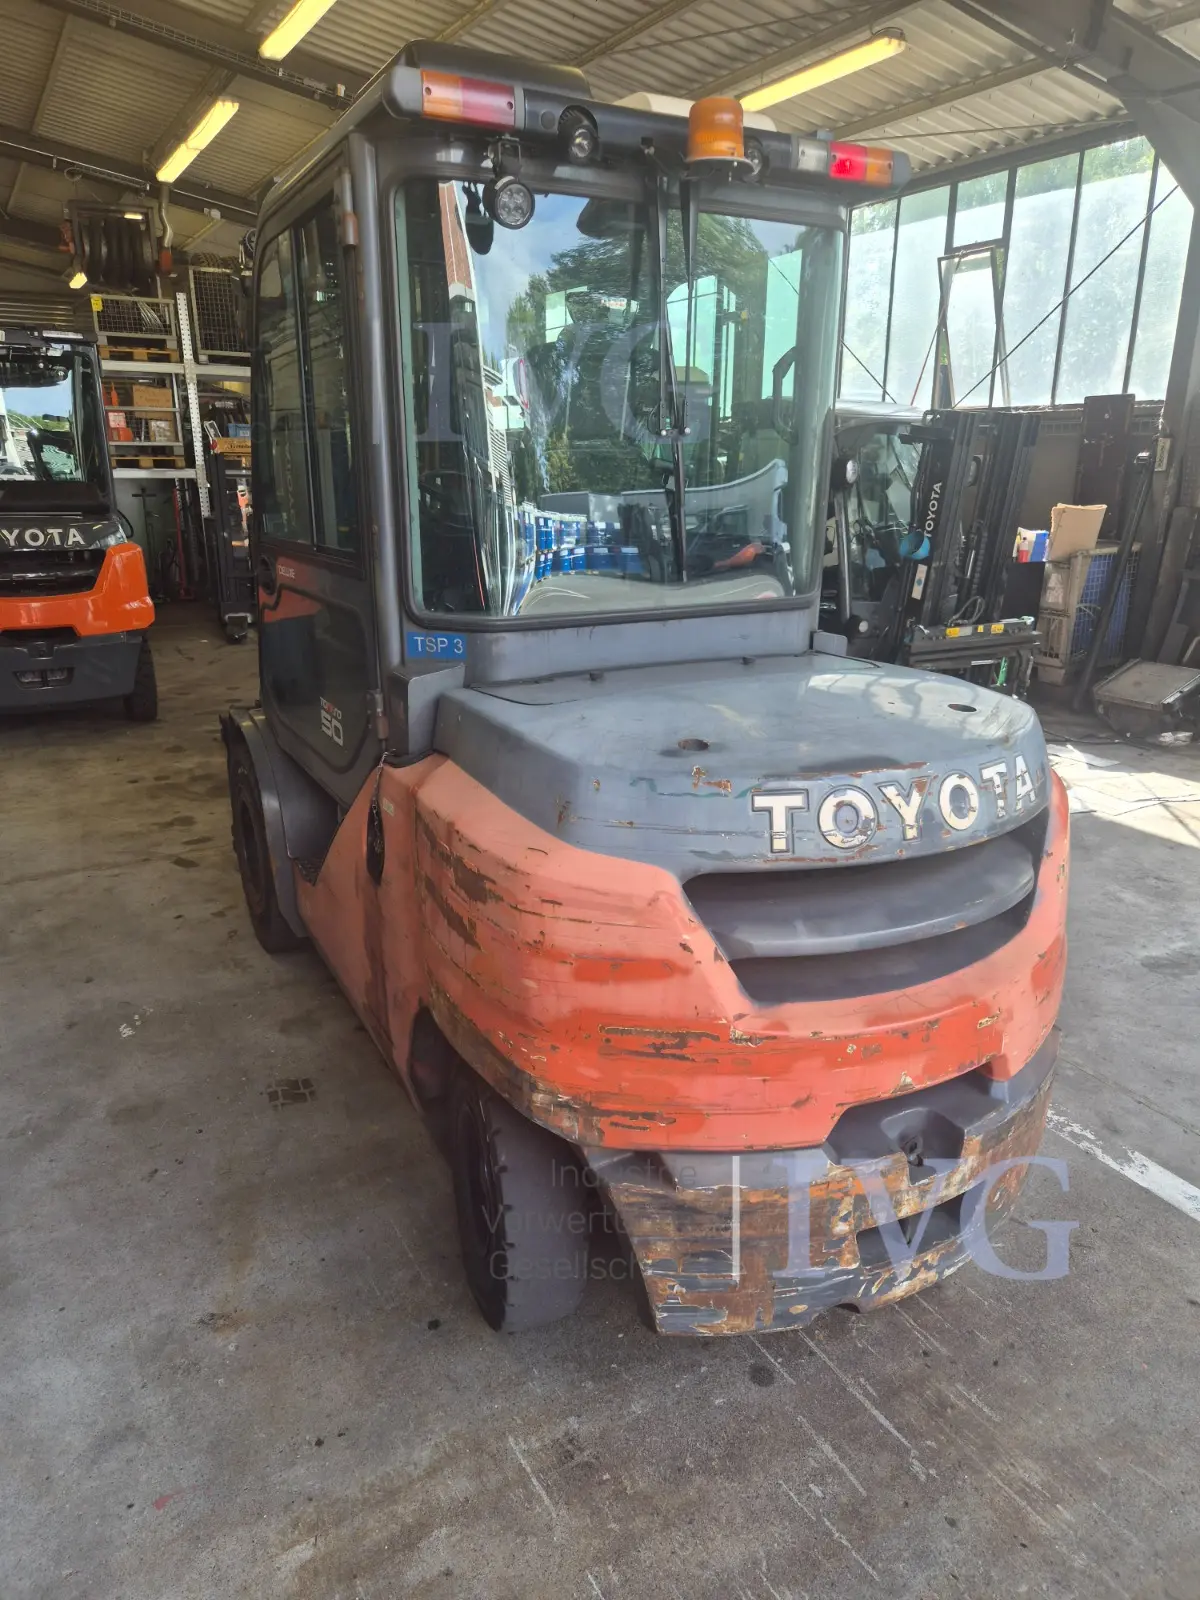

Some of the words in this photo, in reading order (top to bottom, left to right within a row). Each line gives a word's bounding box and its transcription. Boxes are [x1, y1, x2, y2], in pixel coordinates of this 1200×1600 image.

[923, 481, 942, 538] TOYOTA
[412, 636, 449, 653] TSP
[453, 638, 464, 654] 3
[320, 708, 344, 747] 50
[749, 752, 1037, 855] TOYOTA
